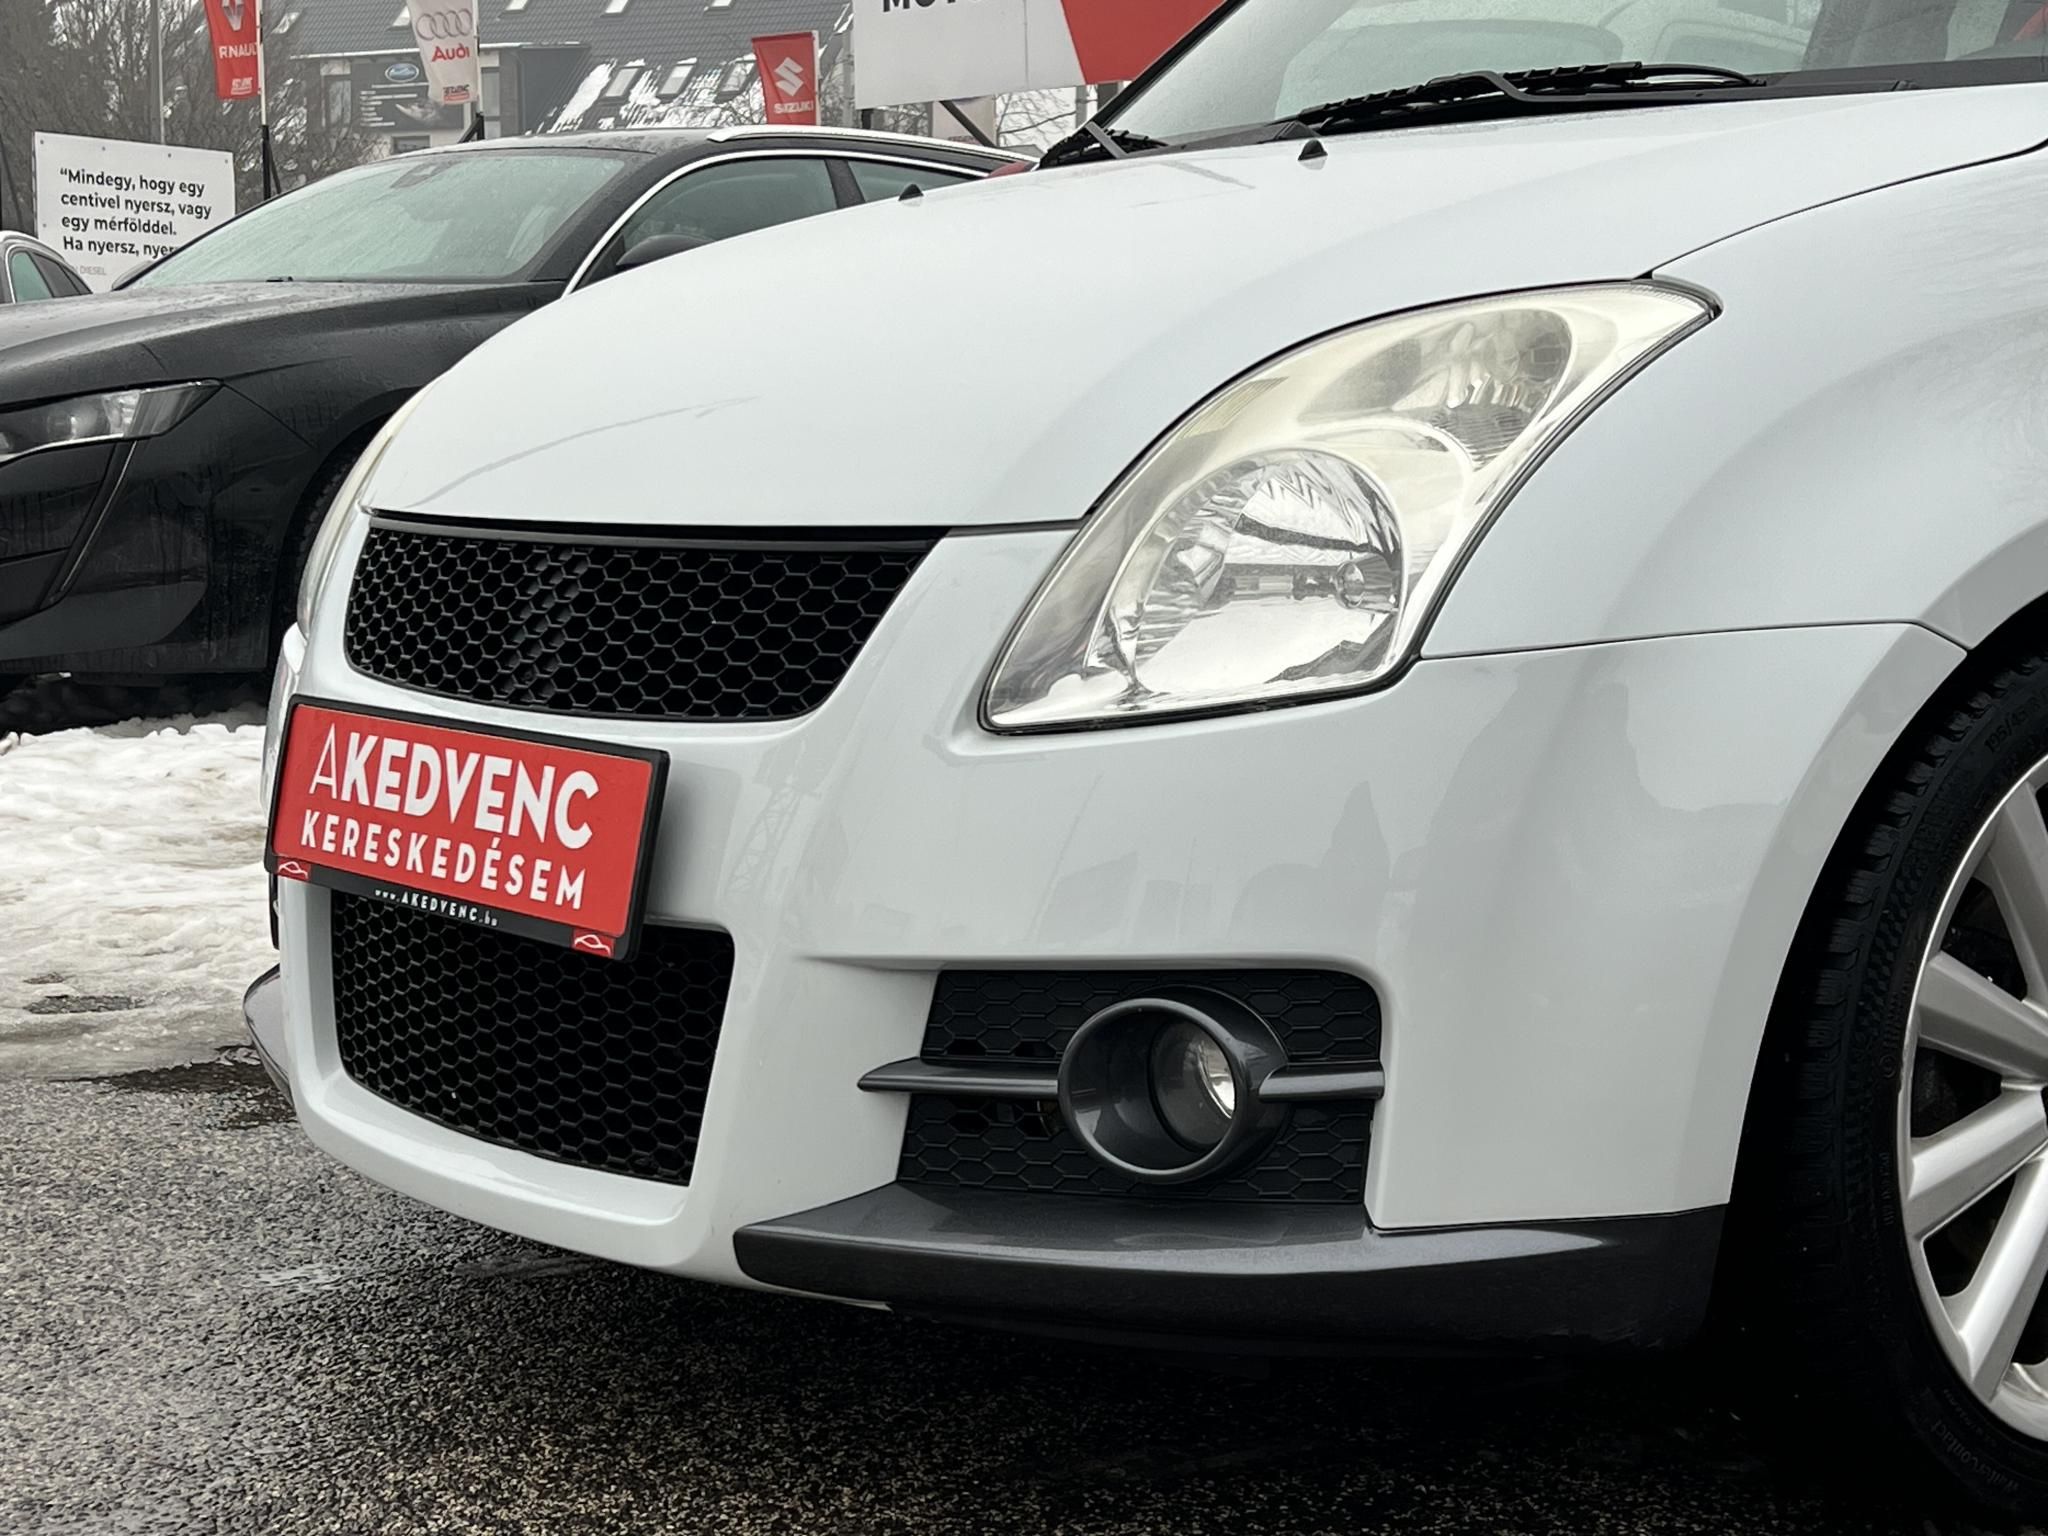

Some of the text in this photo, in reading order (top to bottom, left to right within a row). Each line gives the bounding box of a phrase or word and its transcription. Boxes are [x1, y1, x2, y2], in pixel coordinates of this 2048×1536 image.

[432, 42, 470, 62] Audi
[139, 175, 175, 195] hogy
[179, 181, 205, 198] egy
[61, 192, 212, 220] centivel nyersz, vagy
[61, 217, 177, 236] egy mérfölddel.
[63, 236, 83, 251] Ha
[88, 239, 139, 257] nyersz,
[309, 723, 600, 850] AKEDVENC
[300, 809, 586, 911] KERESKEDÉSEM
[374, 889, 498, 927] www.AKEDVENC.hu
